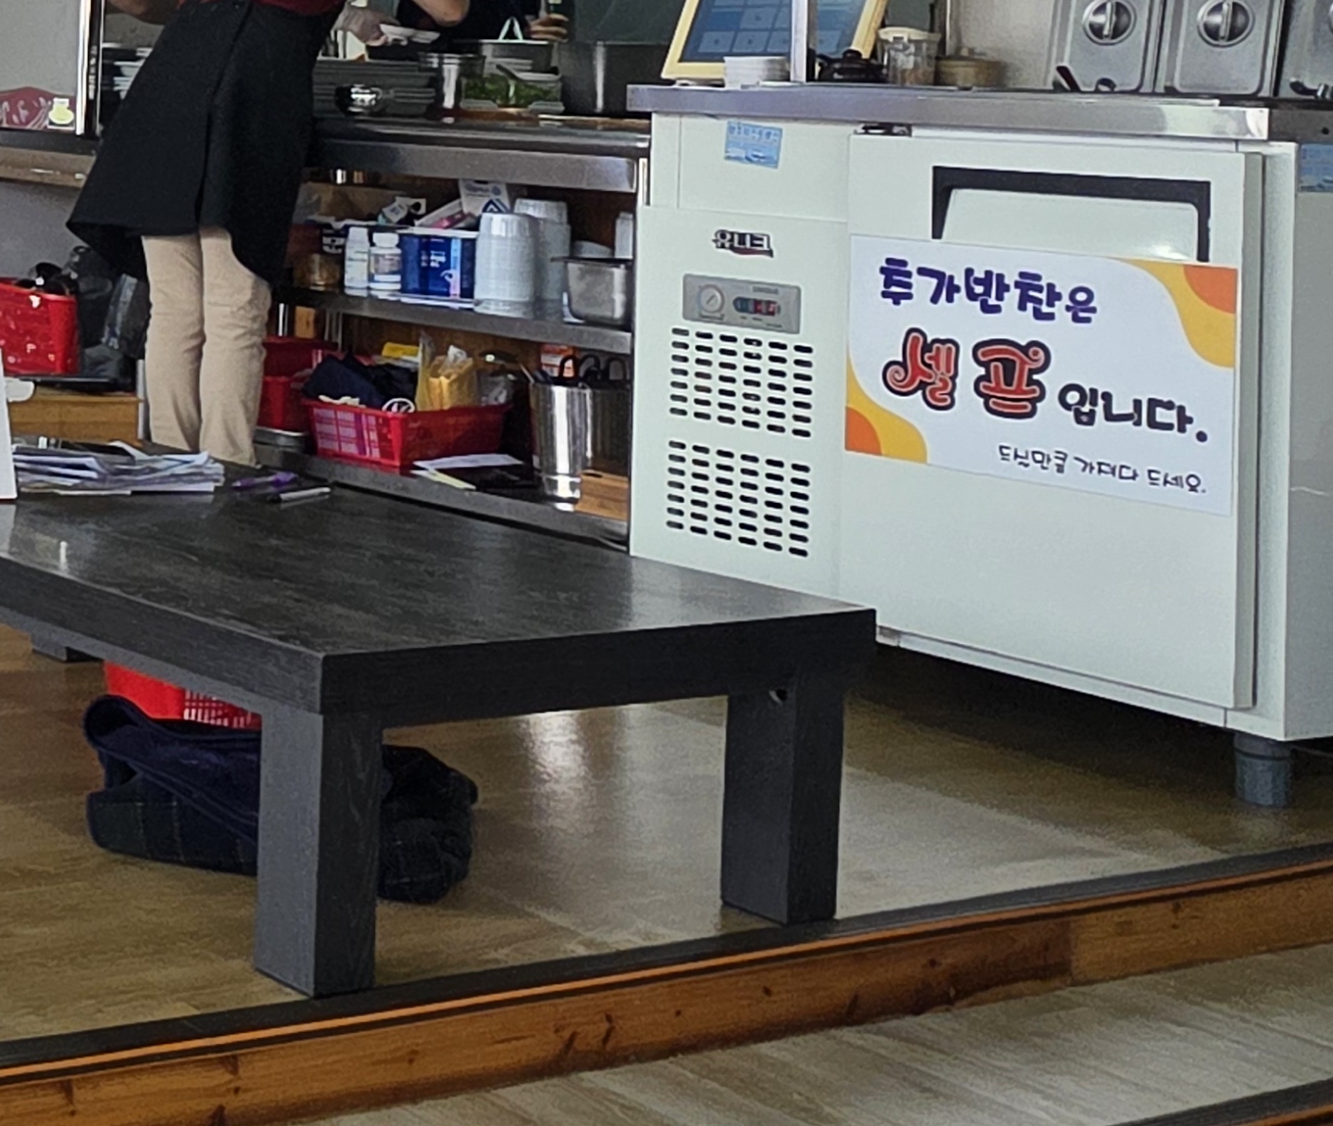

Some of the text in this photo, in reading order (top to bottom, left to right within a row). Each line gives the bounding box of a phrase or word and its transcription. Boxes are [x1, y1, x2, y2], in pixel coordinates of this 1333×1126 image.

[879, 257, 1098, 324] 추가반찬은
[1073, 456, 1140, 481] 가져다
[1146, 468, 1207, 494] 드세요.
